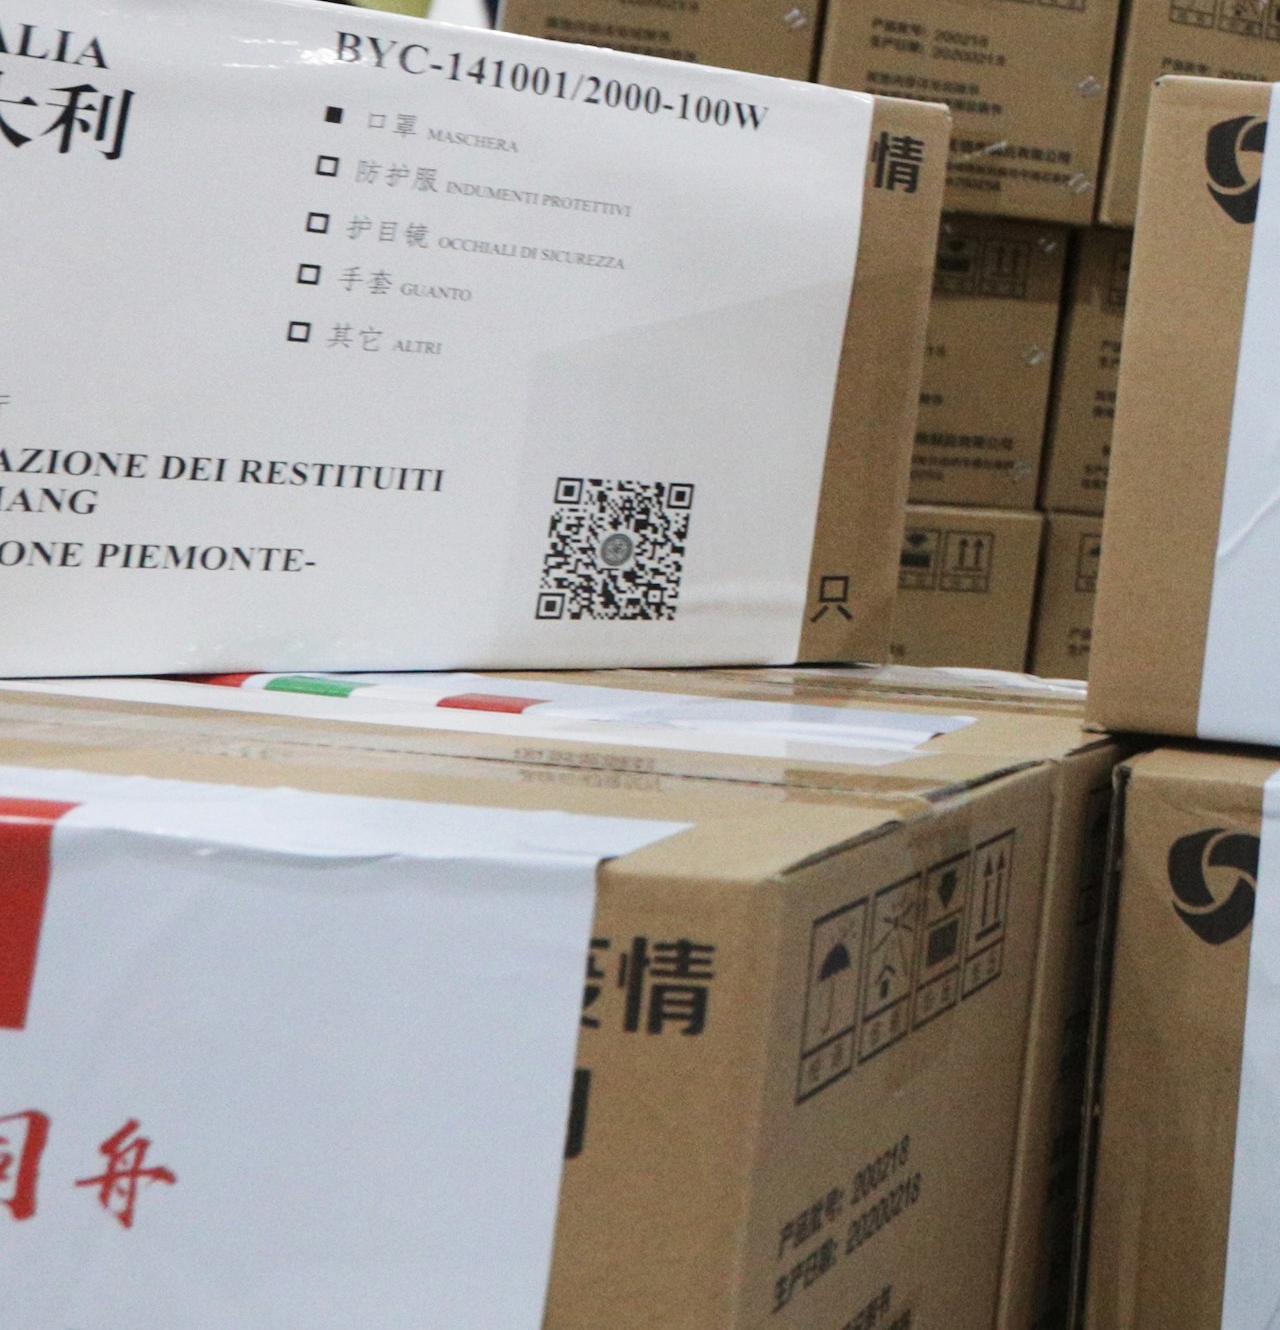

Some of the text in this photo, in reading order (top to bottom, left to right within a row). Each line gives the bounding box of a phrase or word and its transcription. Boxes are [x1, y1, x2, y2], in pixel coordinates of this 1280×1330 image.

[0, 24, 109, 69] LIA
[336, 31, 769, 132] BYC-141001/2000-100W
[367, 112, 519, 153] 口罩 MASCHERA
[871, 131, 925, 193] 情
[354, 159, 632, 218] 防护服 INDUMENTI PROTETTIVI
[346, 215, 625, 270] 护目镜 OCCHIALI DI SICUREZZA
[337, 266, 473, 302] 手套 GUANTO
[326, 322, 443, 356] 其它 ALTRI
[159, 454, 229, 483] DEI
[238, 458, 445, 493] RESTITUITI
[95, 542, 317, 573] PIEMONTE-
[810, 575, 853, 623] 只
